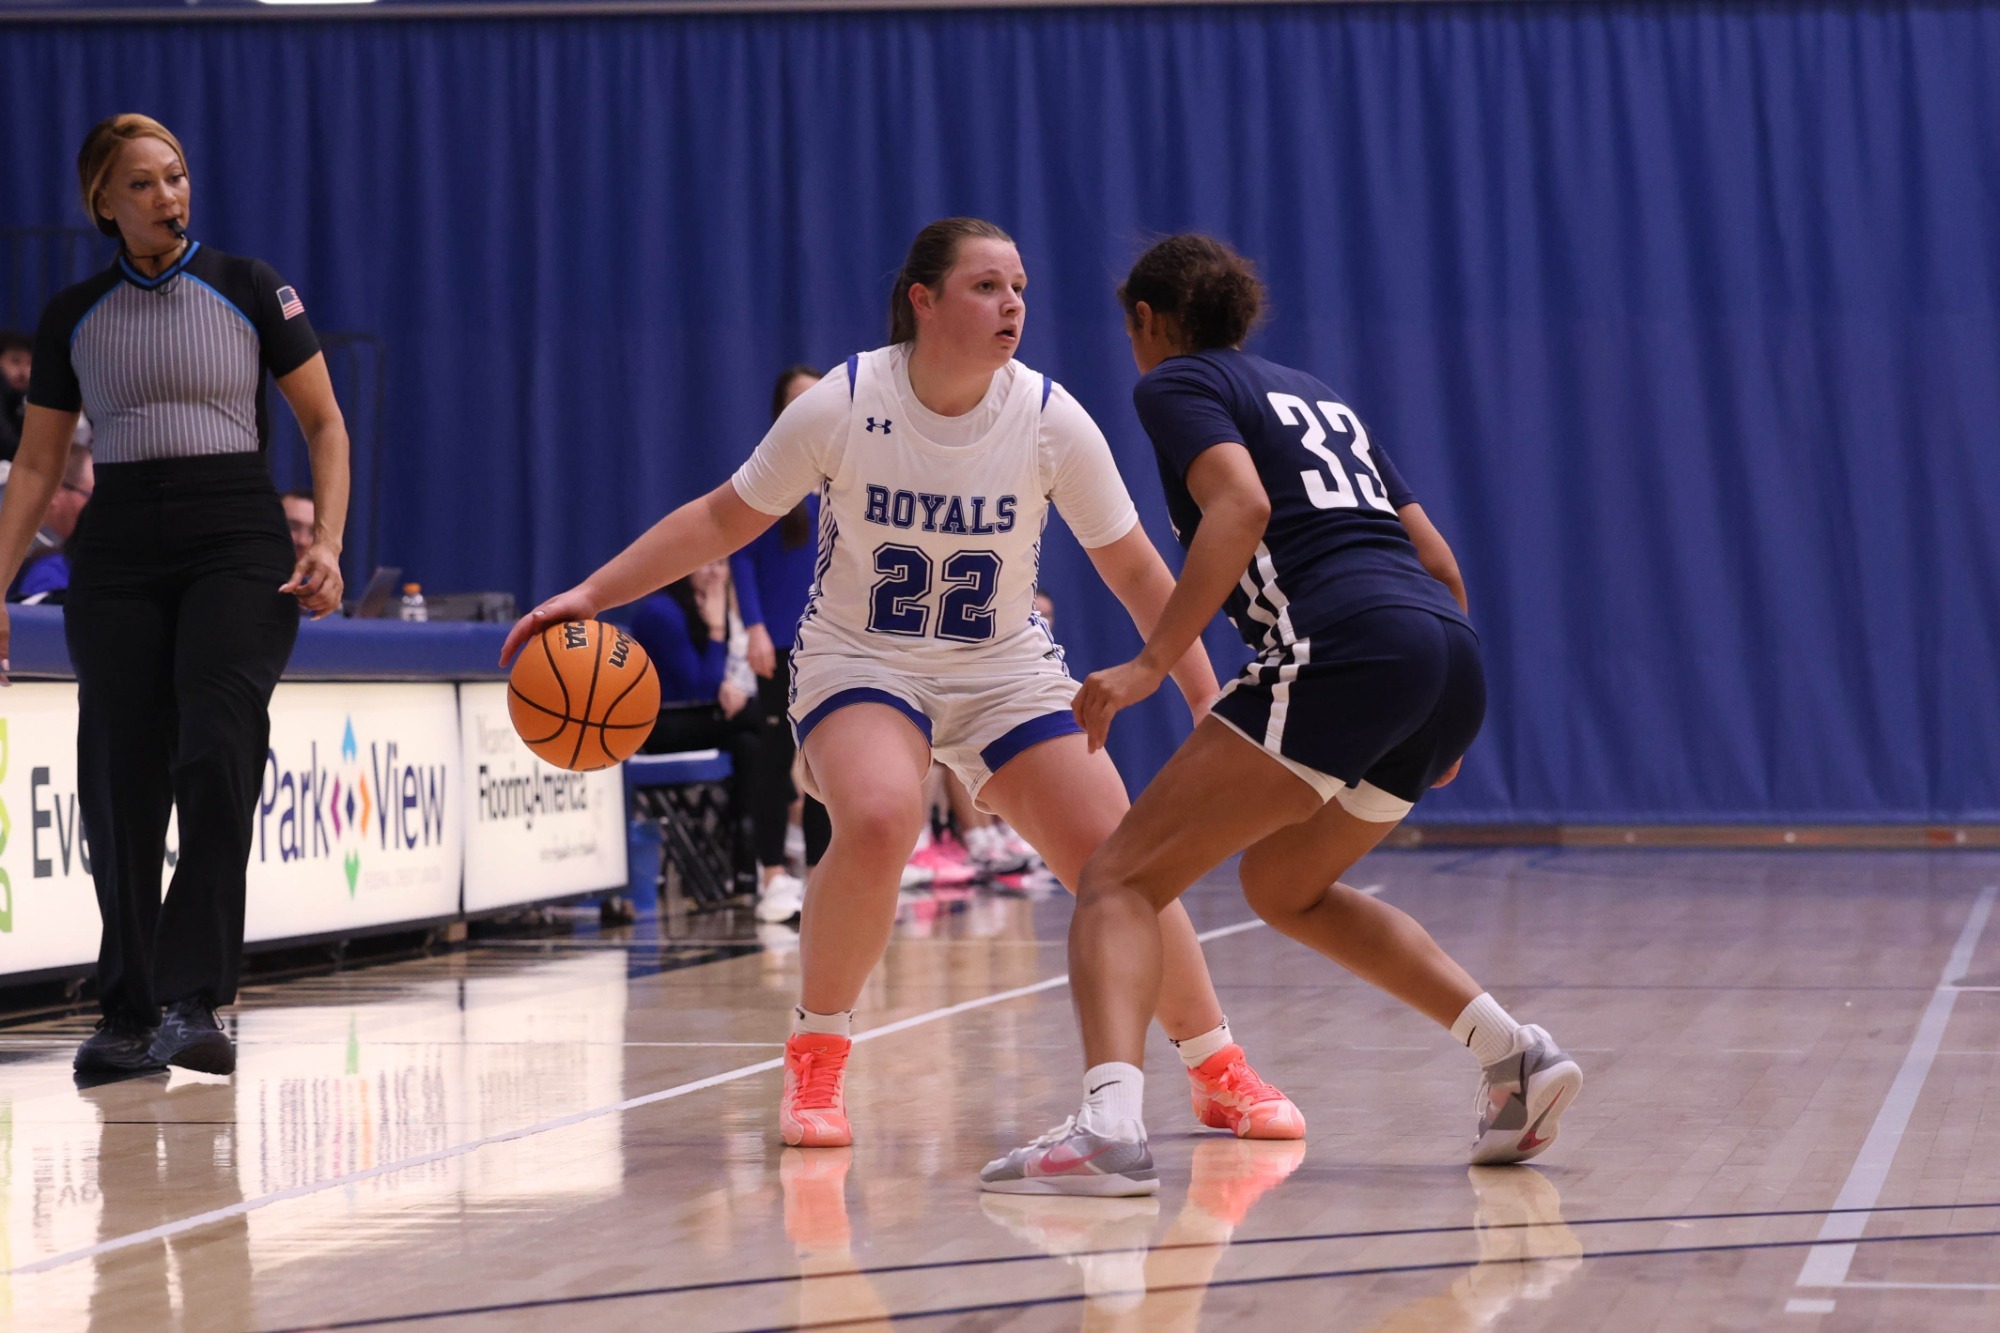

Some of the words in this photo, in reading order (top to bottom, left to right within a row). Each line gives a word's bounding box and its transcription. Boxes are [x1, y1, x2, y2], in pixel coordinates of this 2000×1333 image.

[864, 483, 1018, 536] ROYALS
[1266, 391, 1399, 517] 33
[864, 541, 1004, 644] 22
[260, 740, 330, 863] Park
[371, 740, 446, 851] View
